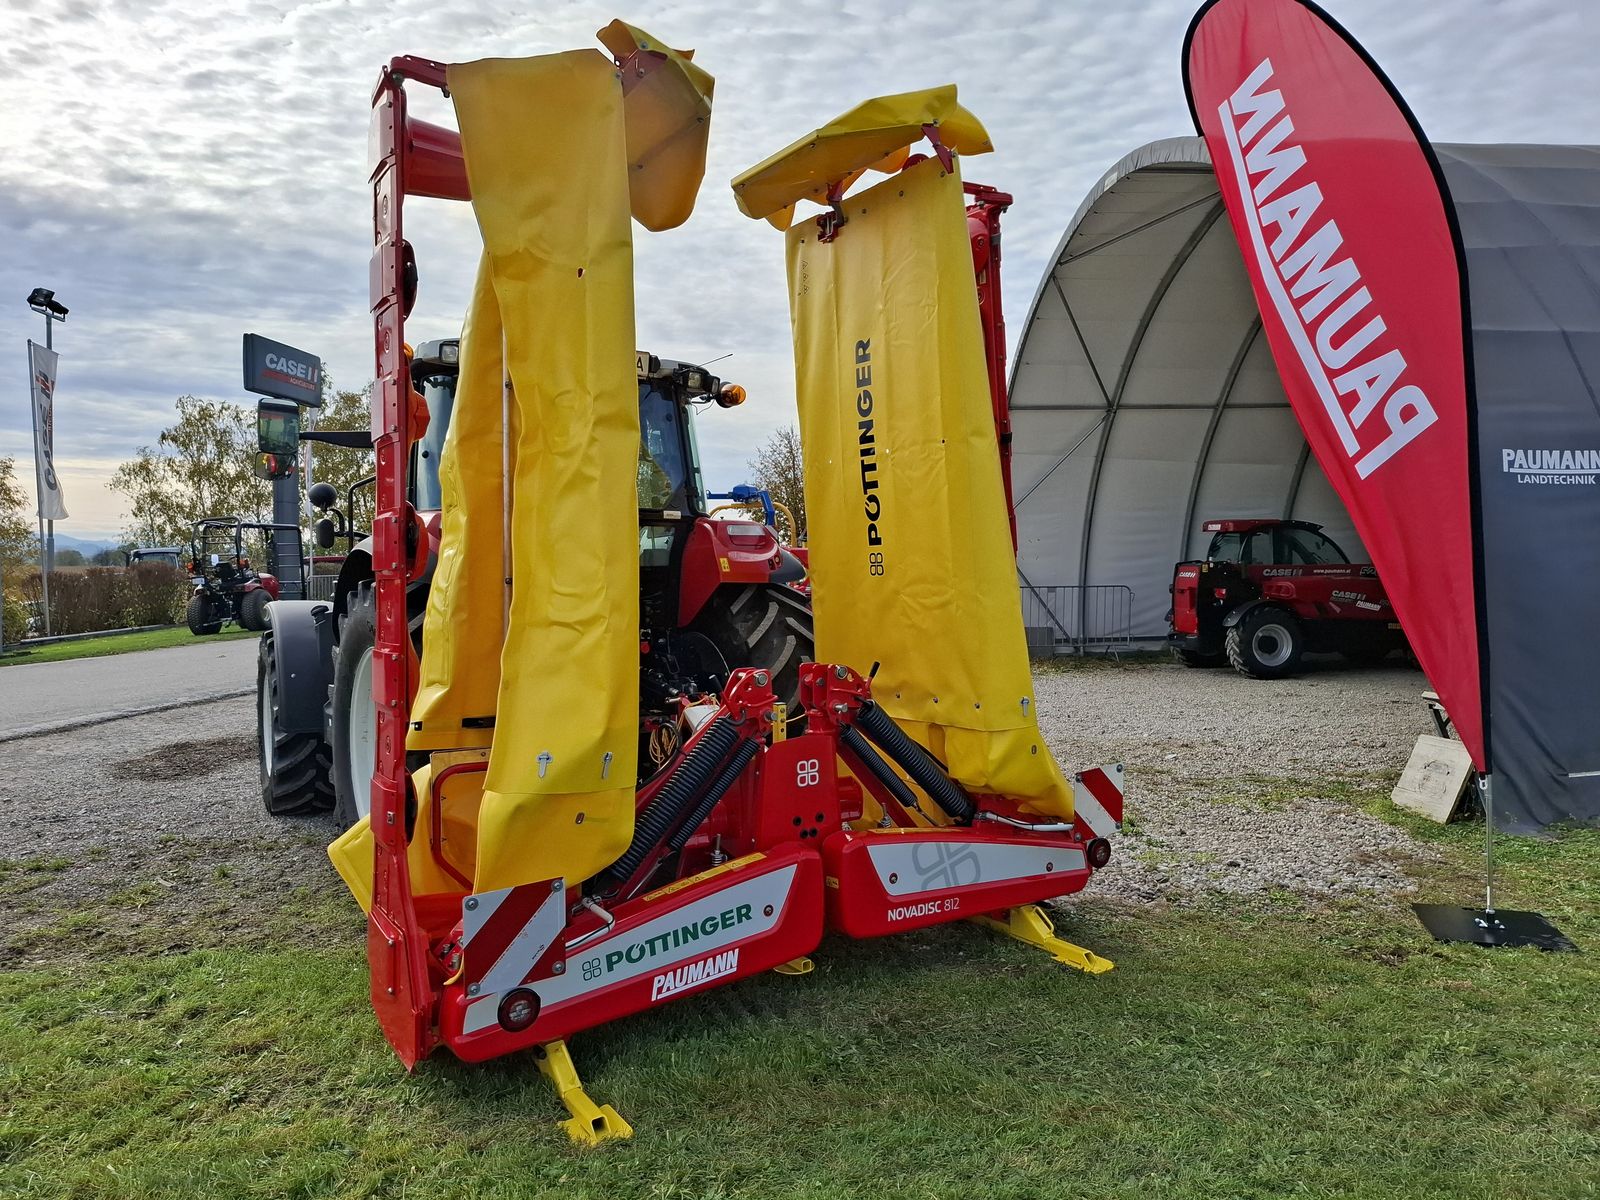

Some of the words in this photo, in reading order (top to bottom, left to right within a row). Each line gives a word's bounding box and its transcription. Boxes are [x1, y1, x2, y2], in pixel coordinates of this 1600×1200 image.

[855, 337, 883, 547] PÖTTINGER
[1517, 474, 1596, 485] LANDTECHNIK
[887, 900, 942, 922] NOVADISC
[943, 897, 961, 912] 812
[605, 903, 753, 973] PÖTTINGER
[651, 948, 740, 1001] PAUMANN
